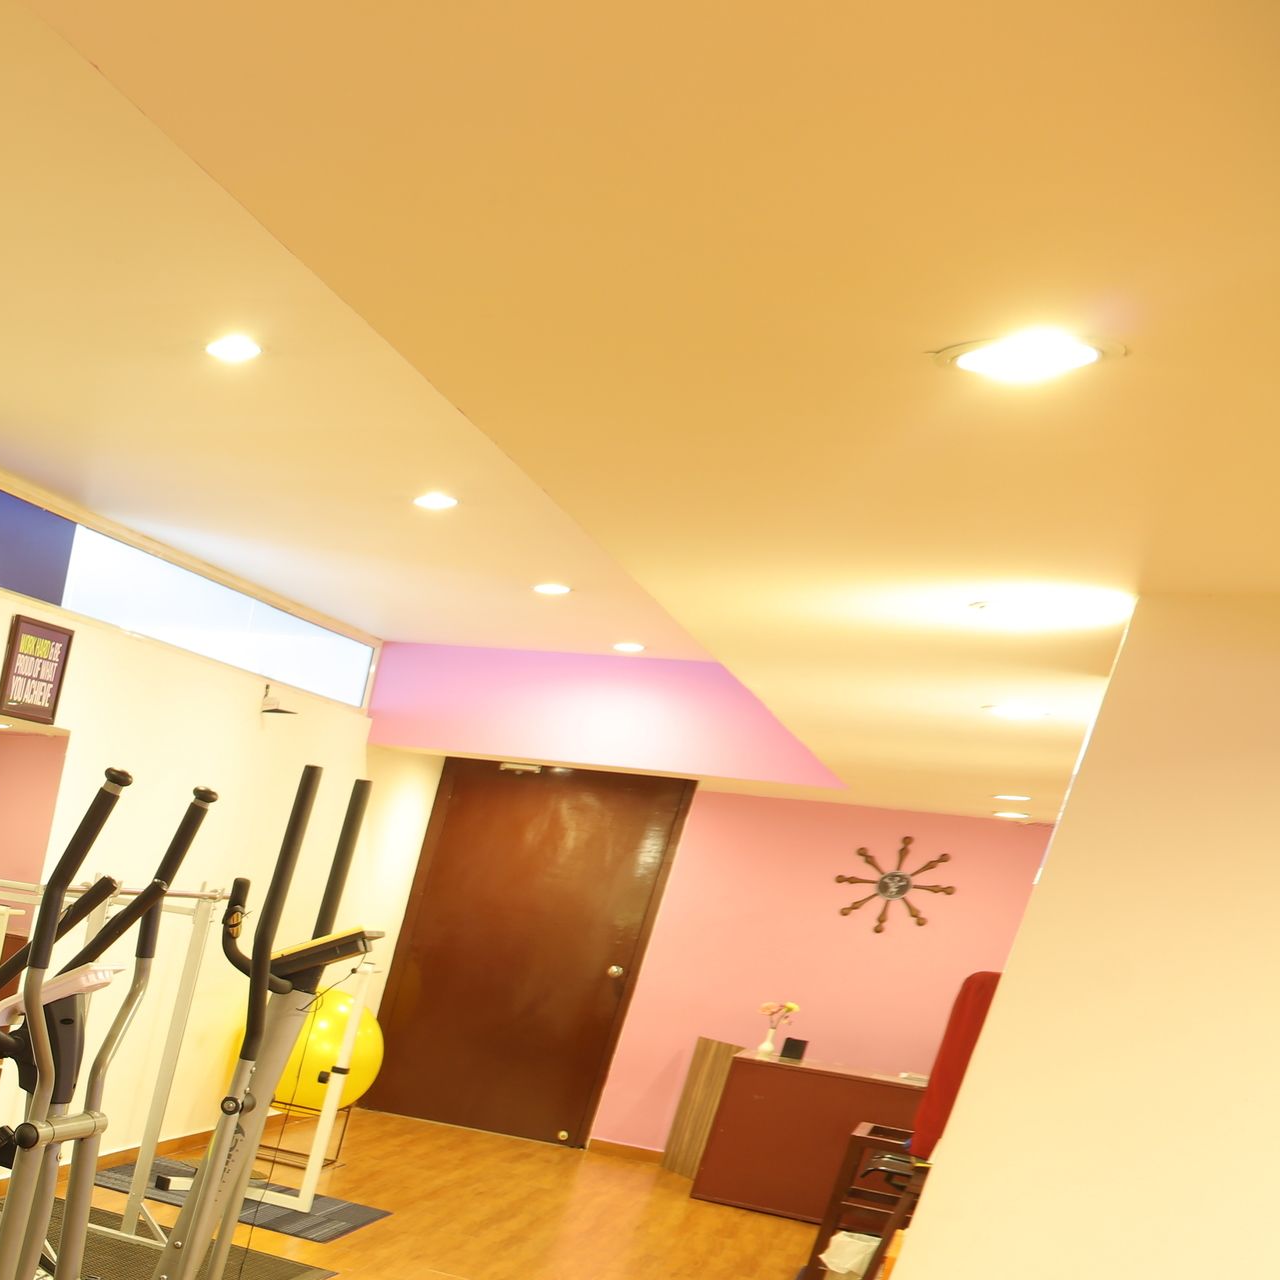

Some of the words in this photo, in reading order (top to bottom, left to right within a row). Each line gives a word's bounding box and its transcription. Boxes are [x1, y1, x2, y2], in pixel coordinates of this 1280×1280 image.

[19, 633, 38, 655] WORK
[35, 638, 51, 659] HARD
[53, 643, 62, 662] BE
[14, 653, 35, 677] PROUD
[32, 658, 42, 678] OF
[39, 660, 58, 682] WHAT
[9, 675, 27, 702] YOU
[22, 678, 53, 707] ACHIEVE
